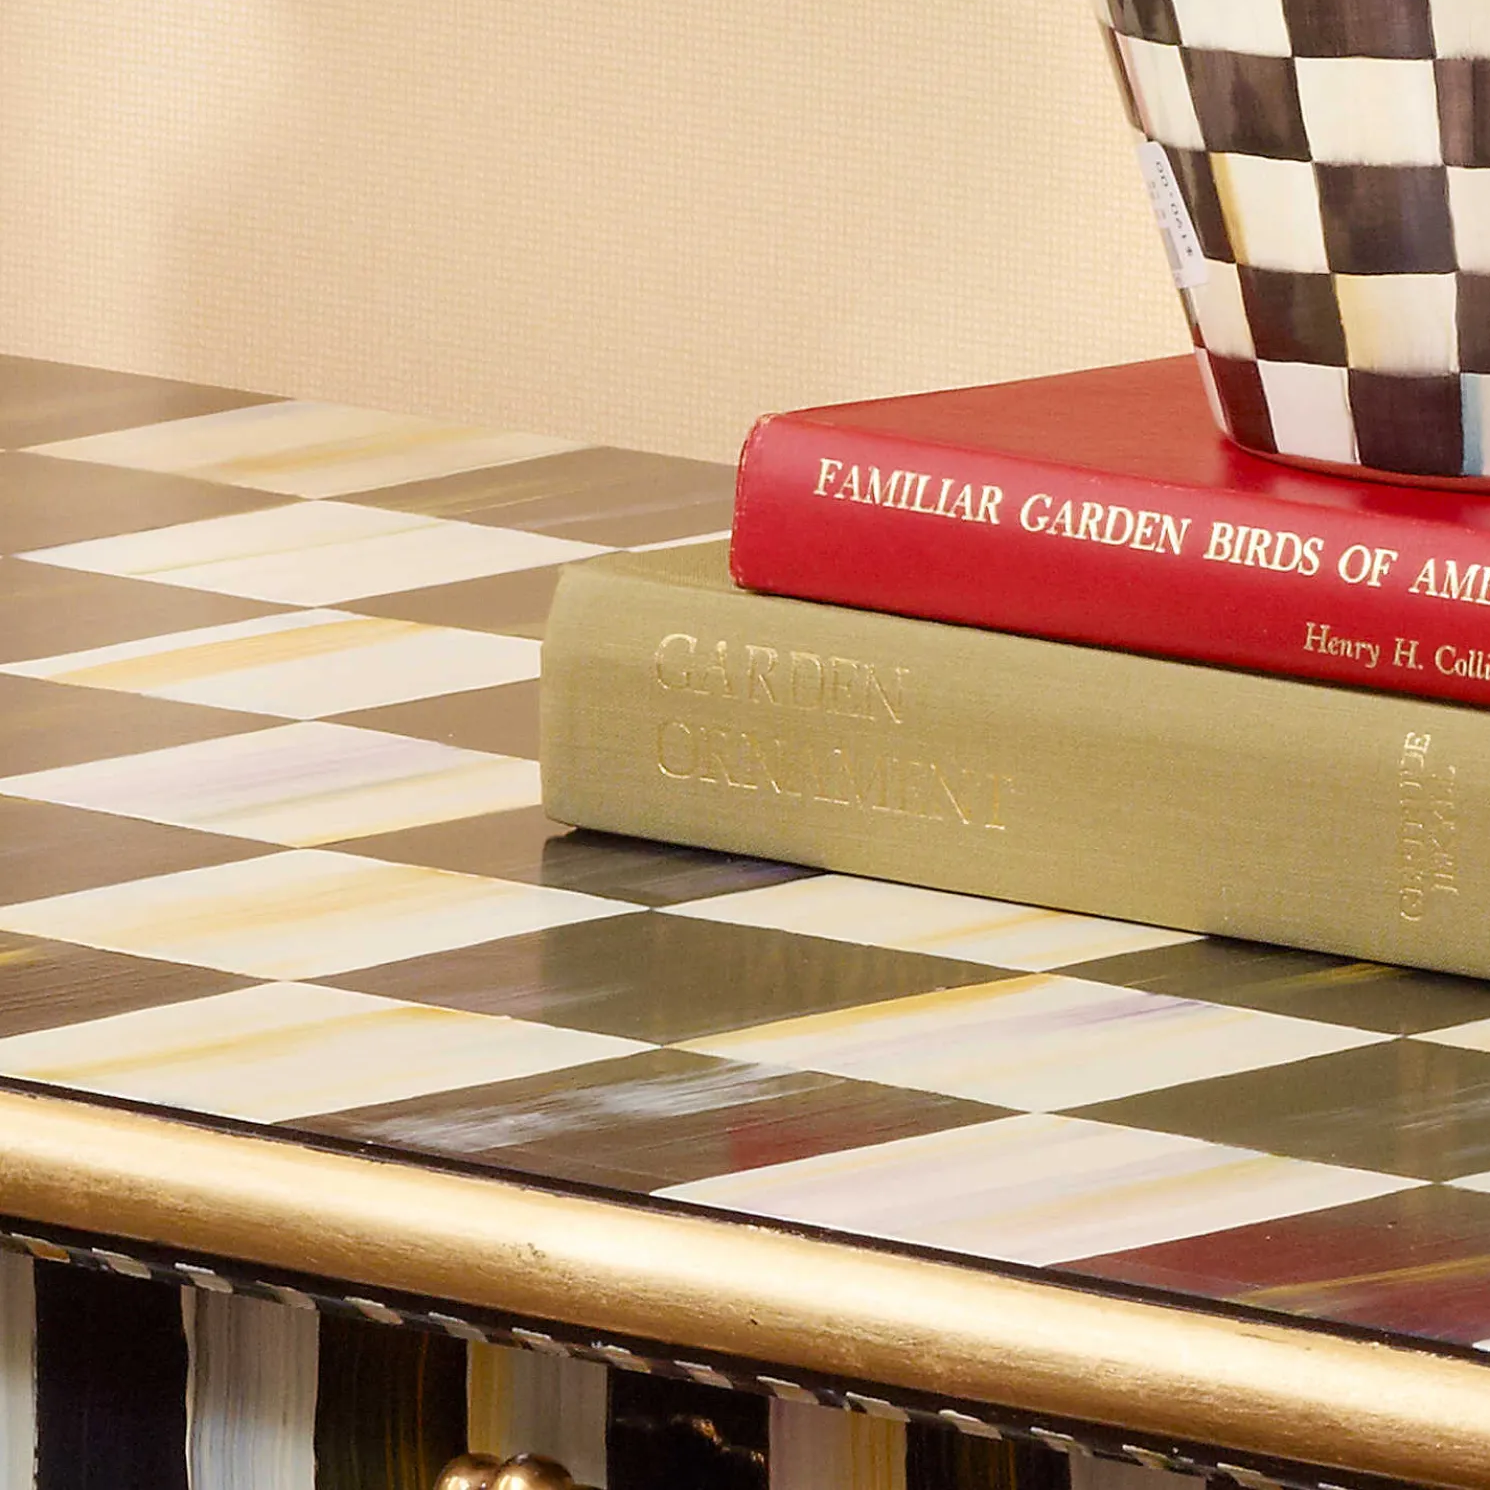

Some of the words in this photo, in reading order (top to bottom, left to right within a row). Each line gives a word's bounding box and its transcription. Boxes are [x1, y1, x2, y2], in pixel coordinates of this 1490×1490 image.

[814, 458, 1002, 524] FAMILIAR
[1020, 492, 1192, 555] GARDEN
[1203, 521, 1325, 575] BIRDS
[1337, 545, 1399, 587] OF
[654, 632, 910, 724] GARDEN
[1304, 622, 1379, 668] Henry
[1394, 638, 1423, 669] H.
